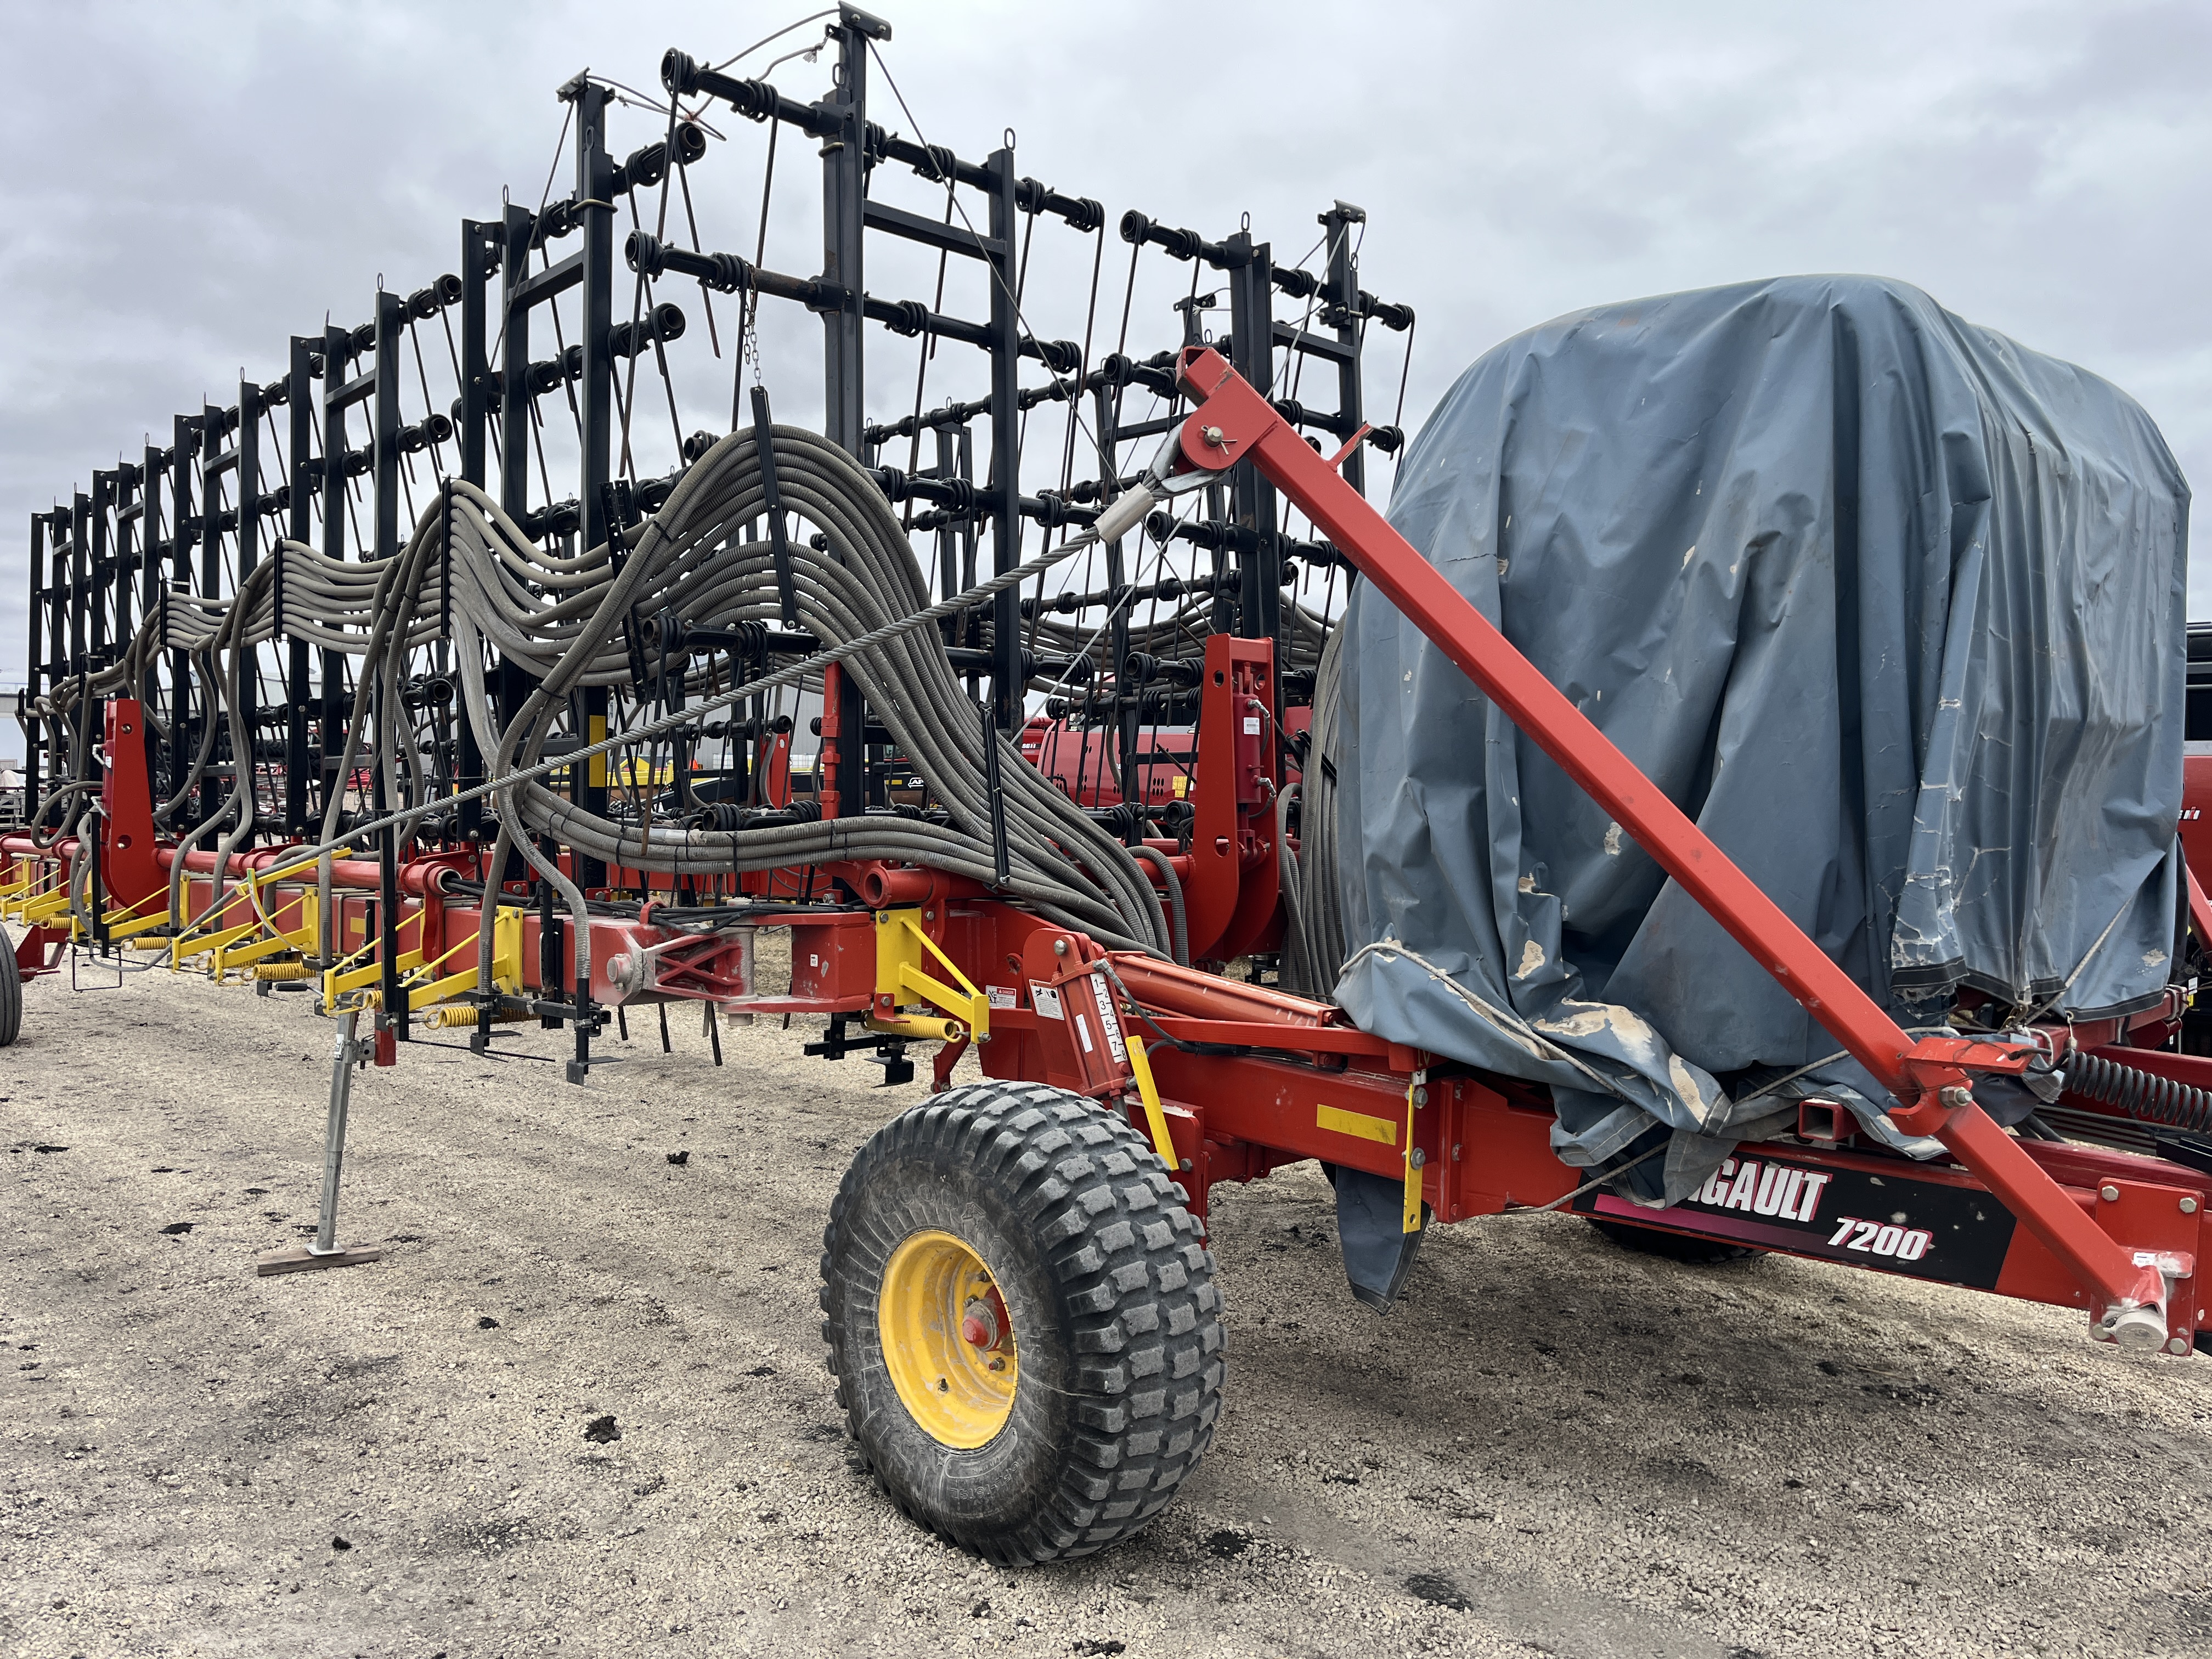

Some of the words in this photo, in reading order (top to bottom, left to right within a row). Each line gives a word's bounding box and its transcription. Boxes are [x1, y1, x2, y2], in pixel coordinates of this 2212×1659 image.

[1094, 979, 1099, 988] 1
[1103, 989, 1109, 998] 2
[1099, 1001, 1106, 1010] 3
[1110, 1009, 1115, 1018] 4
[1105, 1020, 1112, 1030] 5
[1115, 1029, 1120, 1039] 6
[1111, 1041, 1117, 1051] 7
[1121, 1050, 1126, 1059] 8
[1827, 1216, 1933, 1260] 7200
